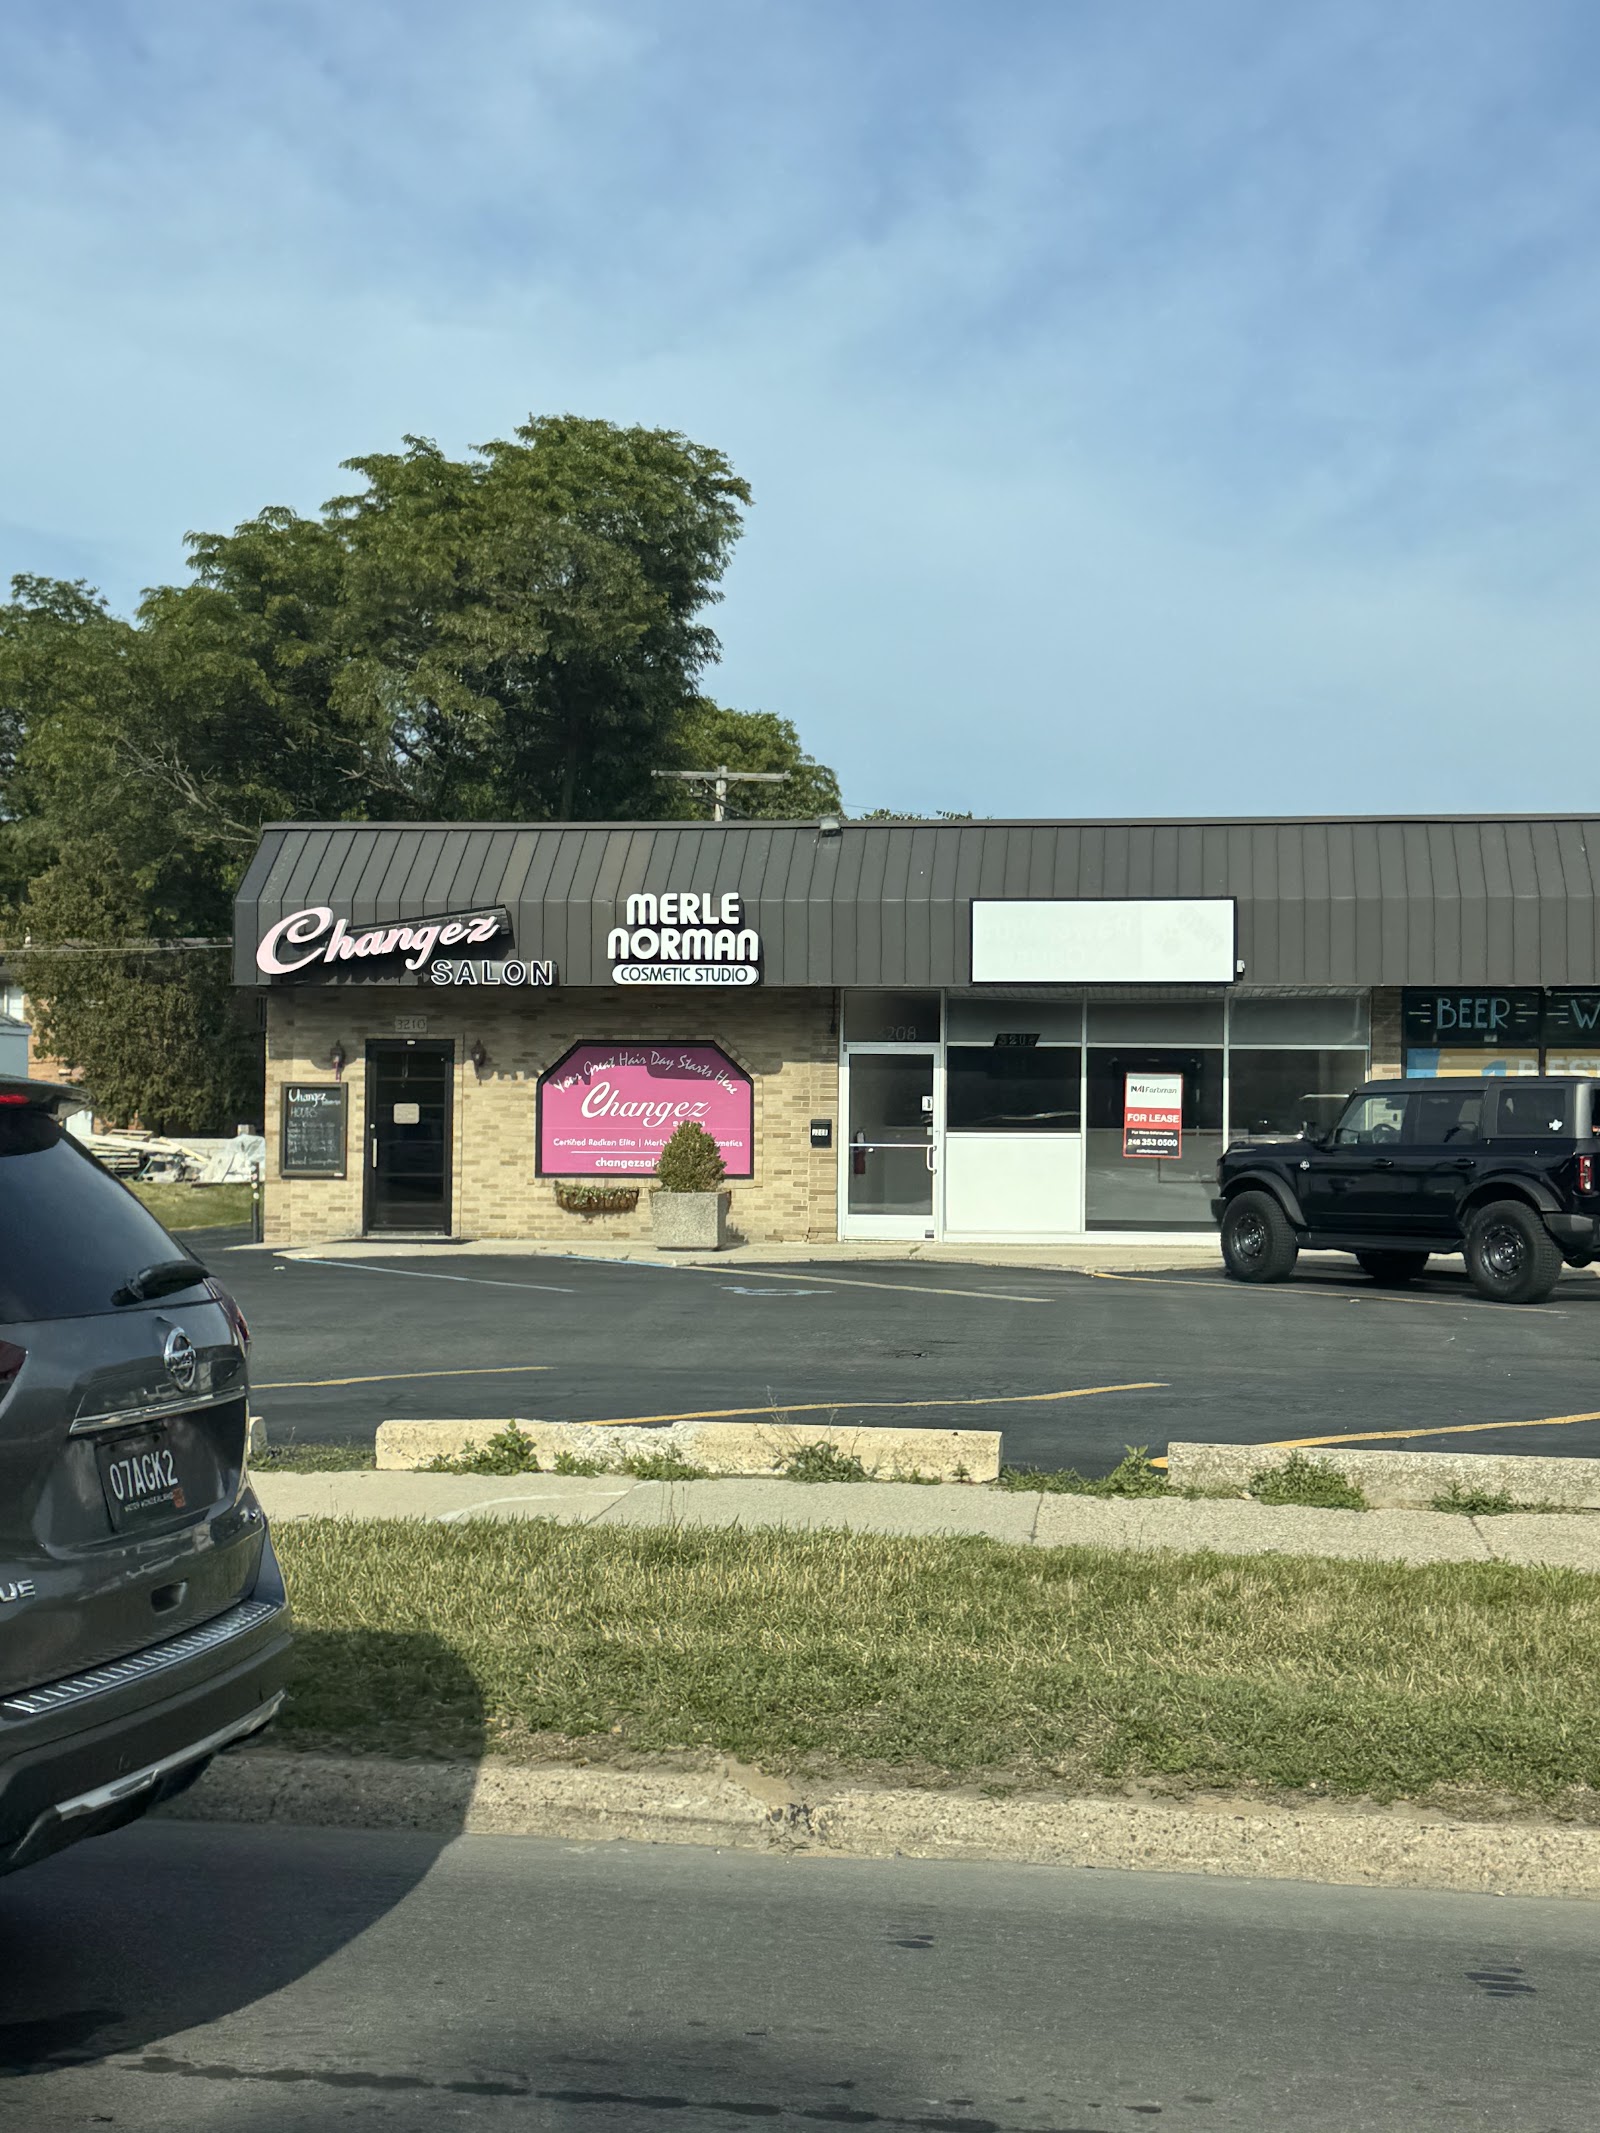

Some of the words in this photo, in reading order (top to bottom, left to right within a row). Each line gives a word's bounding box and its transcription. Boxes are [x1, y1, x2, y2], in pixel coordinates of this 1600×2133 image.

[626, 892, 740, 925] MERLE
[256, 906, 500, 975] Changez
[607, 927, 759, 961] NORMAN
[431, 959, 554, 986] SALON
[621, 967, 691, 982] COSMETIC
[695, 967, 748, 982] STUDIO
[396, 1019, 426, 1030] 3210
[1437, 998, 1511, 1030] BEER
[584, 1056, 616, 1076] Great
[619, 1051, 647, 1066] Hair
[650, 1050, 675, 1071] Day
[677, 1054, 713, 1078] Starts
[714, 1069, 738, 1095] Here
[581, 1081, 712, 1128] Changez
[1127, 1113, 1147, 1122] FOR
[1149, 1113, 1180, 1123] LEASE
[553, 1137, 586, 1147] Certified
[619, 1138, 636, 1147] Elite
[109, 1449, 179, 1501] 07AGK2
